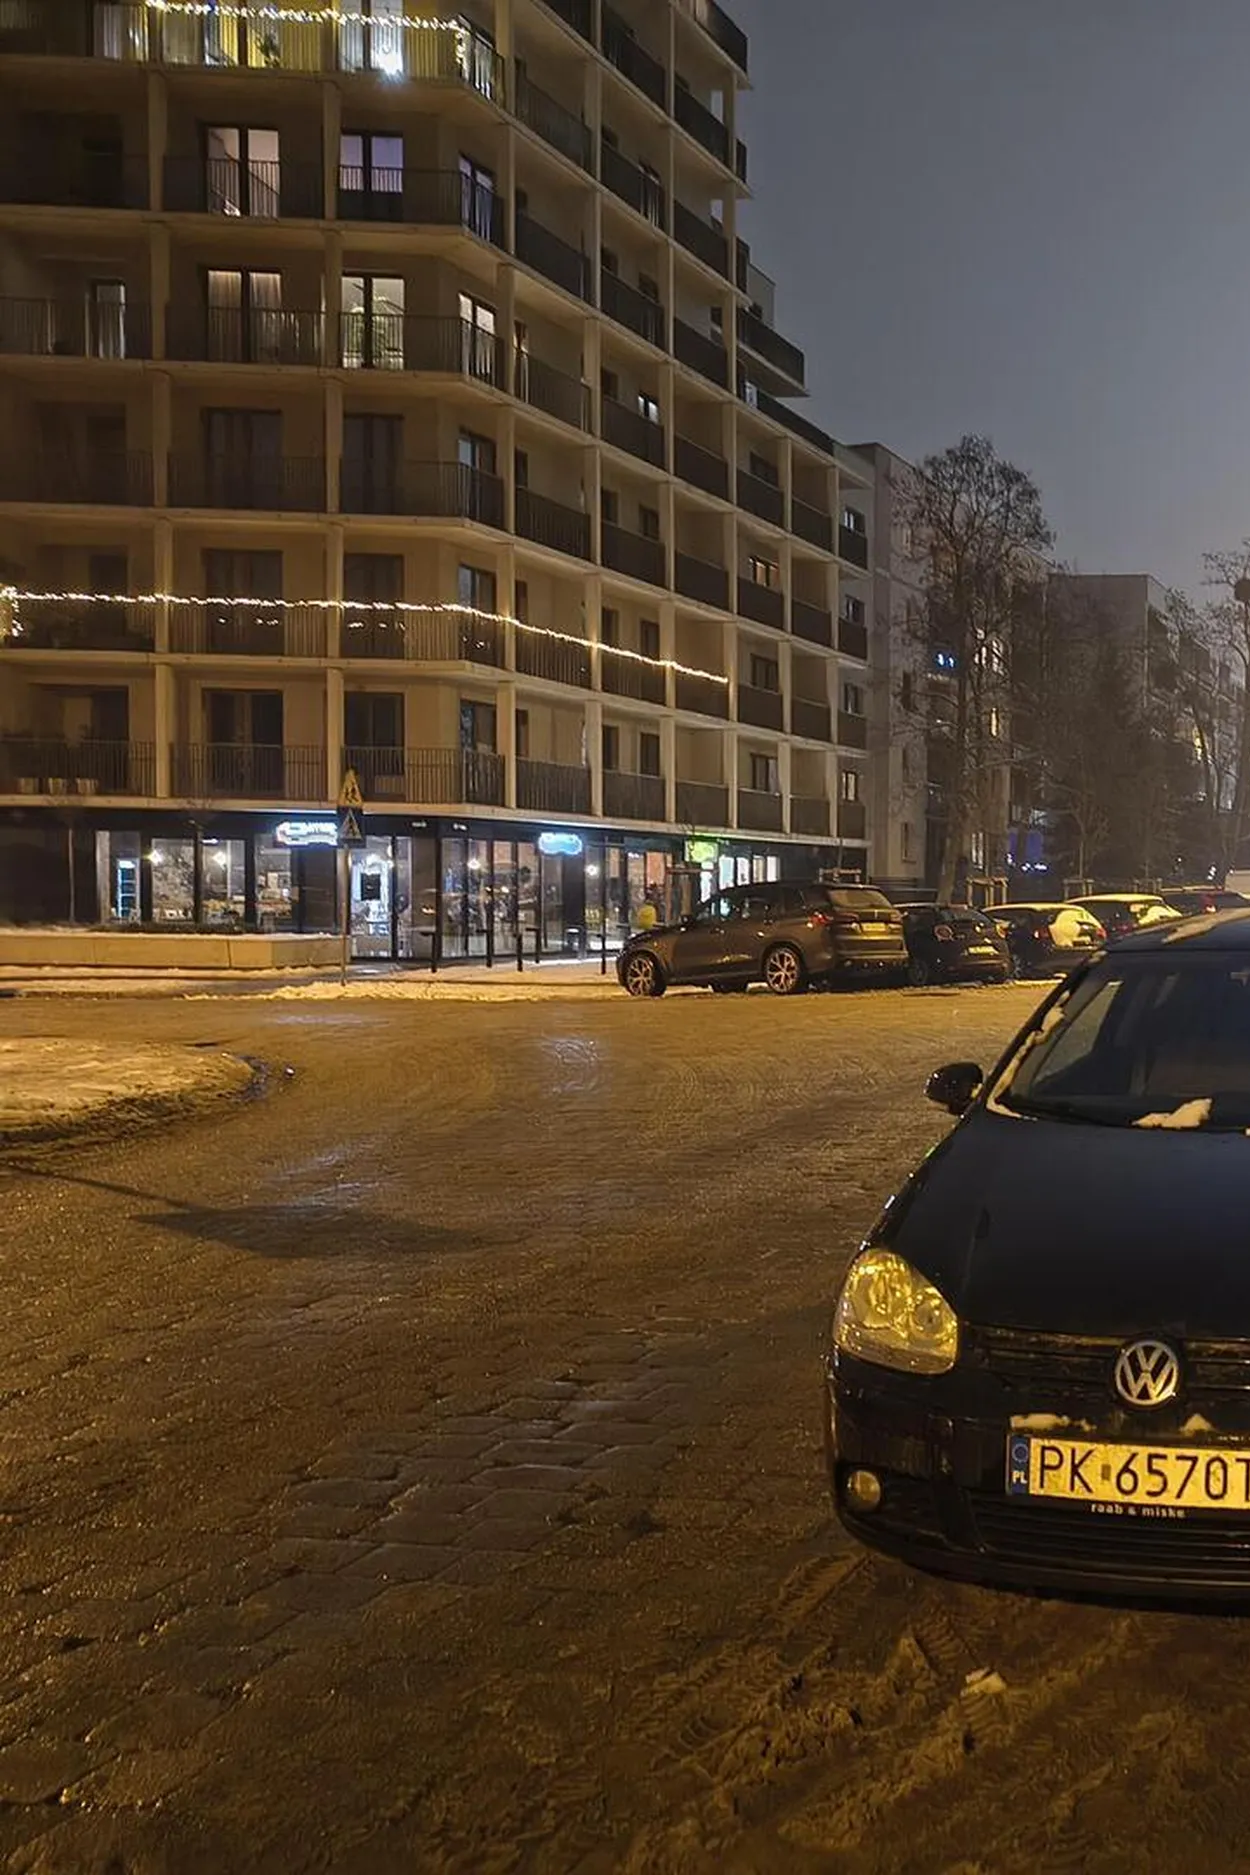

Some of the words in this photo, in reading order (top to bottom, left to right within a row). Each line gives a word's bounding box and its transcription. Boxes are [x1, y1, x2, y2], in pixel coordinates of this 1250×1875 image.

[1039, 1444, 1096, 1493] PK
[1011, 1470, 1028, 1485] PL
[1090, 1503, 1124, 1516] raab
[1141, 1507, 1186, 1519] miske
